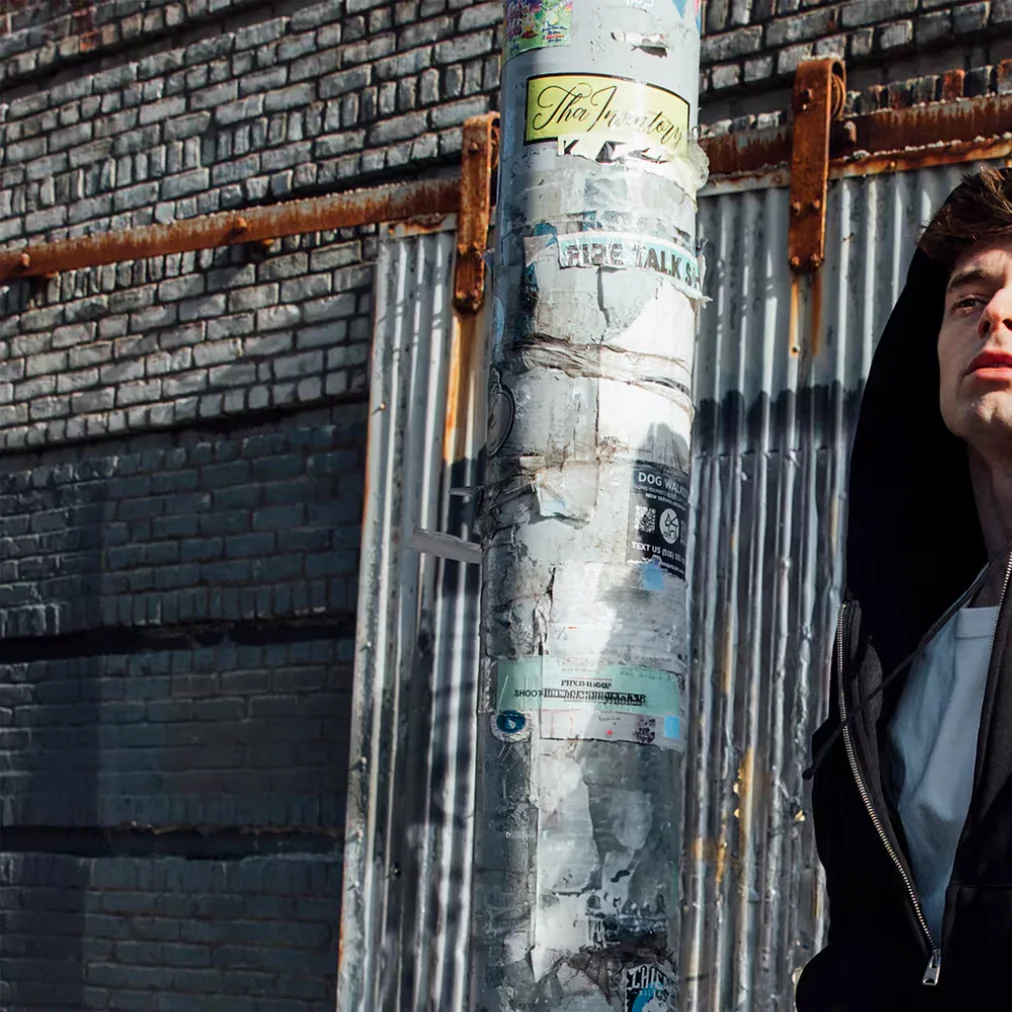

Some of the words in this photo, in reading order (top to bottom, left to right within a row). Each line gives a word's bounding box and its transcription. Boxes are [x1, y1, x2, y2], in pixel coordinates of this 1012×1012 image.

[638, 472, 662, 487] DOG
[631, 542, 651, 552] TEXT
[652, 545, 661, 554] US
